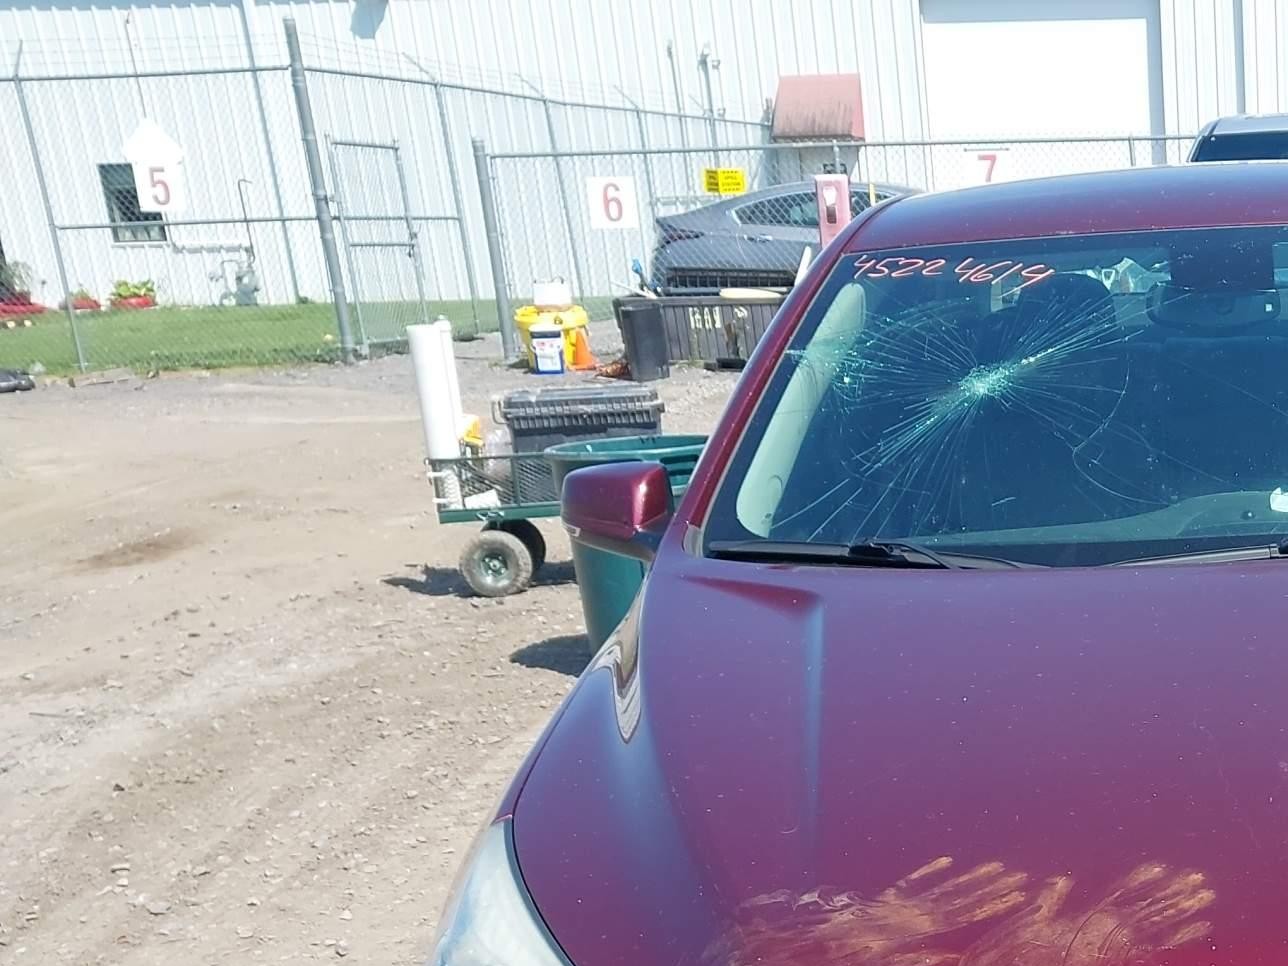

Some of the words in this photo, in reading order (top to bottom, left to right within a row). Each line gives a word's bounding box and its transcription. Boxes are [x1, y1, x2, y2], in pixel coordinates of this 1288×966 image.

[149, 167, 170, 205] 5
[977, 154, 996, 182] 7
[603, 183, 623, 222] 6
